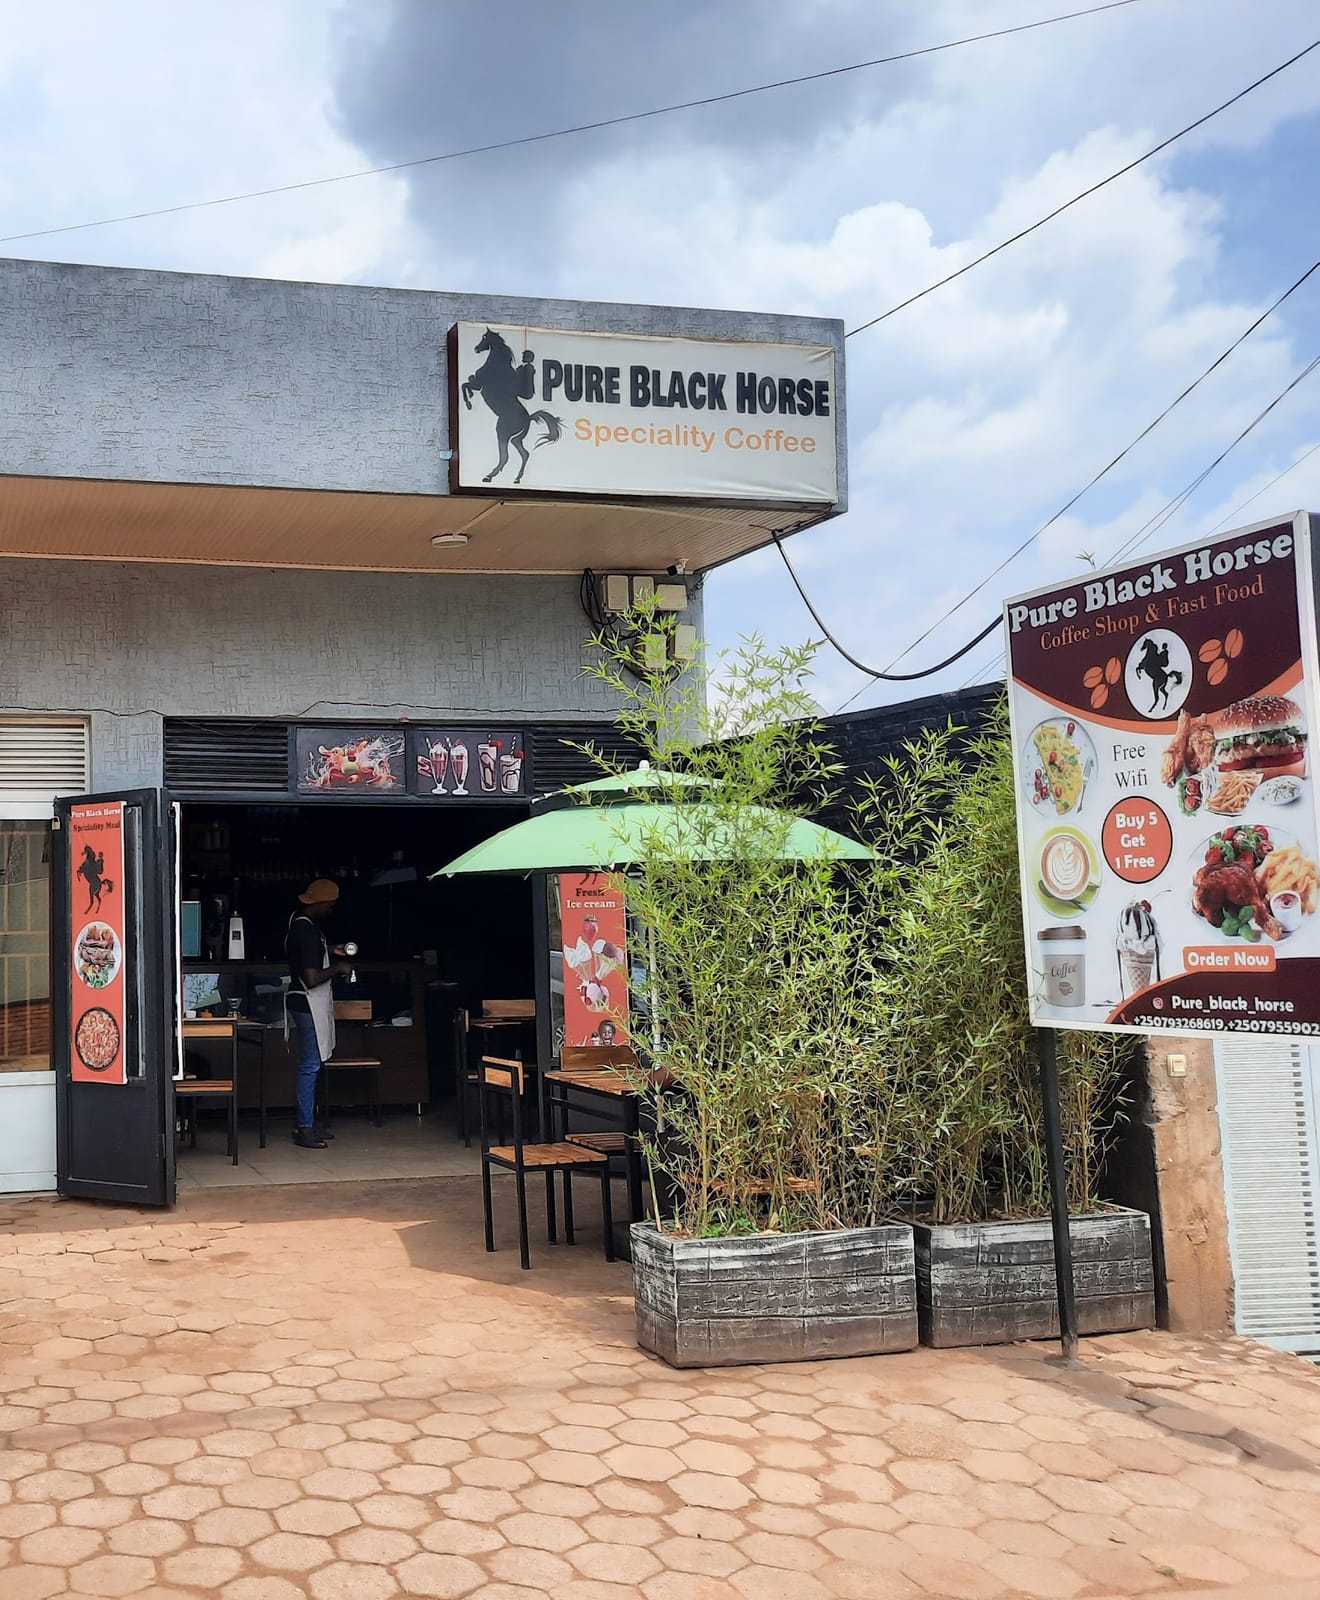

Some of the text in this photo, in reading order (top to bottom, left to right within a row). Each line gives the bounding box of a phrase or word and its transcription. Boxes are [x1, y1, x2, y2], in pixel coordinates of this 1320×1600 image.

[542, 359, 831, 417] PURE BLACK HORSE
[574, 418, 817, 454] Speciality Coffee
[1009, 533, 1294, 633] Pure Black Horse
[1040, 574, 1265, 651] Coffee Shop & Fast Food
[1113, 744, 1146, 762] Free
[1115, 768, 1148, 788] Wifi
[1115, 812, 1158, 829] Buy 5
[1120, 834, 1145, 847] Get
[1115, 854, 1155, 869] 1 Free
[566, 900, 581, 908] Ice
[1187, 951, 1269, 967] Order Now
[1171, 995, 1294, 1014] Pure_black_horse
